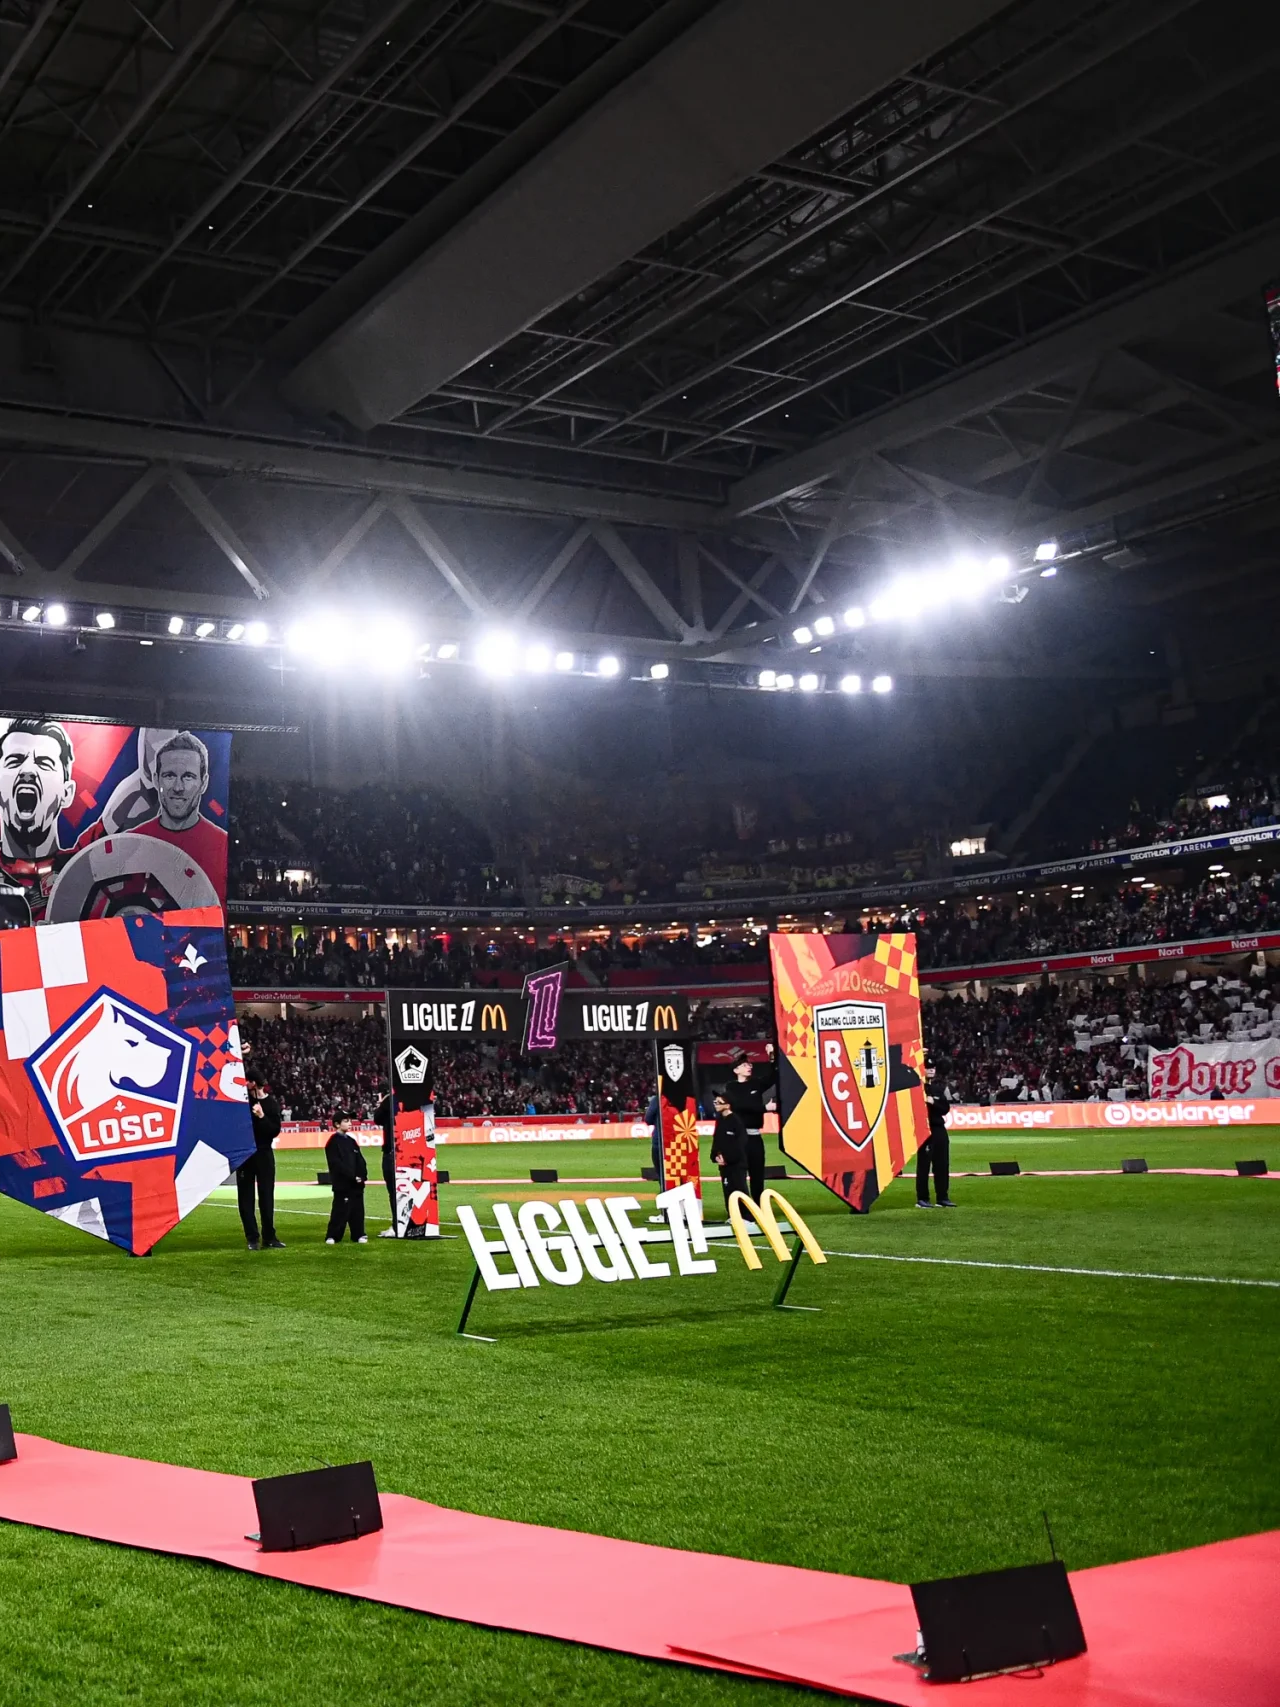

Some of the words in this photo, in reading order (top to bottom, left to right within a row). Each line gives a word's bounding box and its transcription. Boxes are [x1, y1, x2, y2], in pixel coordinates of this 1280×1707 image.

[1229, 831, 1273, 845] DECATHLON
[1130, 848, 1170, 861] DECATHLON
[1183, 842, 1213, 852] ARENA
[1089, 857, 1115, 868] ARENA
[306, 906, 329, 914] ARENA
[1231, 937, 1258, 949] Nord
[1090, 953, 1115, 965] Nord
[1158, 946, 1184, 958] Nord
[834, 970, 861, 992] 120
[402, 1003, 458, 1031] LIGUE
[582, 1004, 633, 1031] LIGUE
[820, 1016, 842, 1027] RACING
[842, 1015, 856, 1026] CLUB
[858, 1015, 865, 1025] DE
[866, 1013, 881, 1025] LENS
[954, 1107, 1054, 1127] boulanger
[1131, 1103, 1255, 1123] boulanger
[81, 1112, 165, 1148] LOSC
[510, 1126, 594, 1142] boulanger
[456, 1196, 671, 1291] LIGUE
